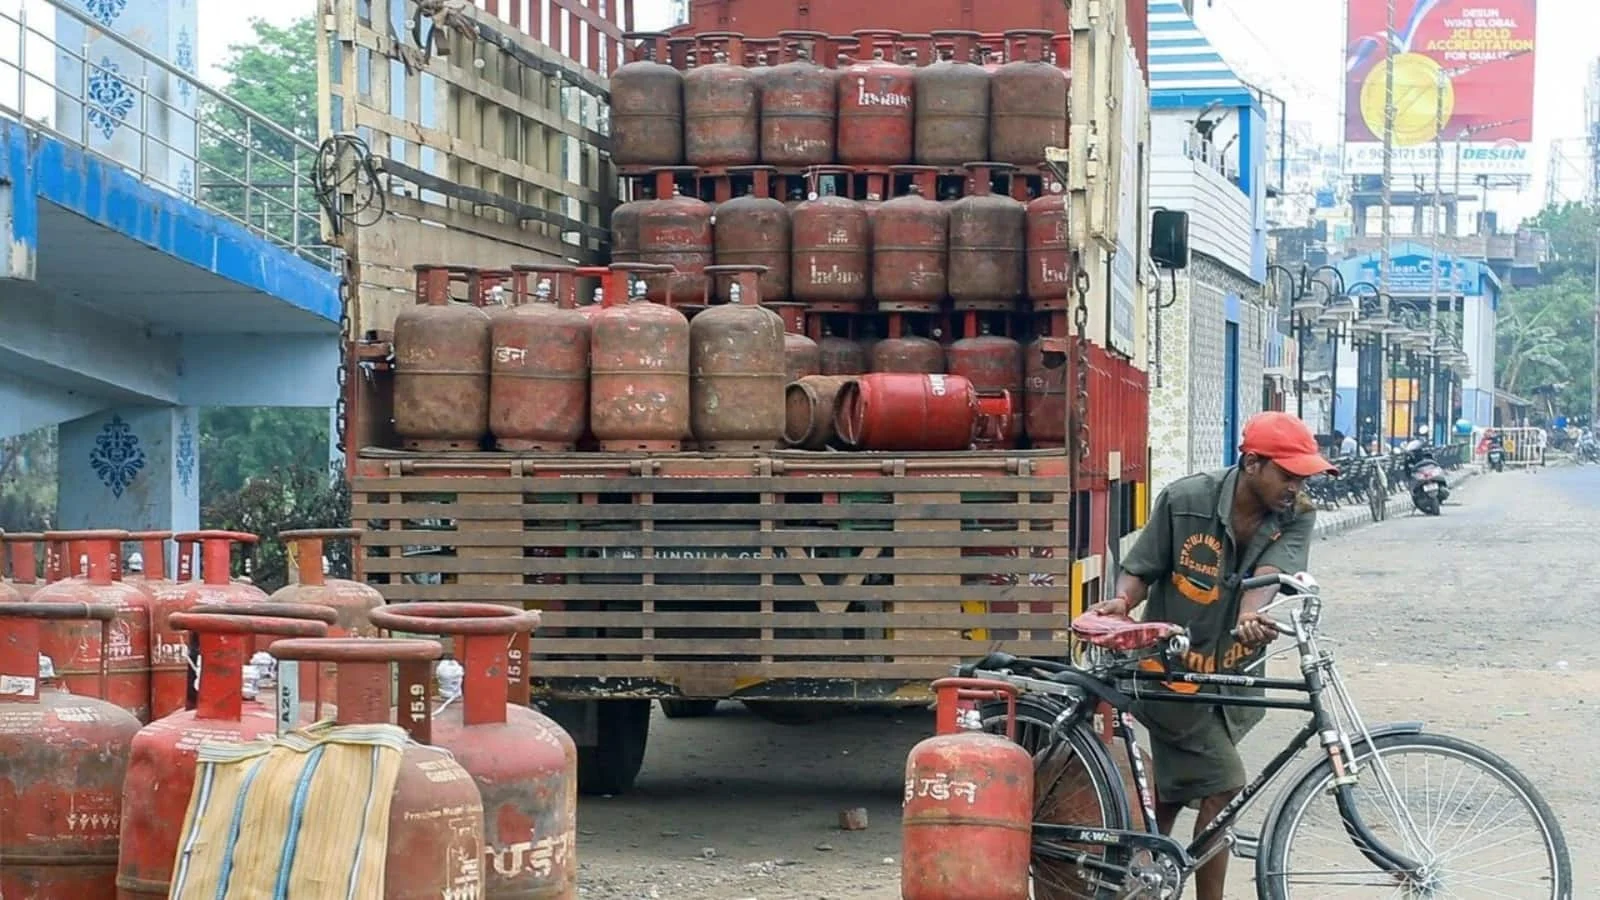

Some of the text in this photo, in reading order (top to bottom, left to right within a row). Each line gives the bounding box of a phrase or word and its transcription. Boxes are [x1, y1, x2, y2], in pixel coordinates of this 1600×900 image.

[1462, 8, 1499, 17] DESUN
[1444, 18, 1518, 28] WINS GLOBAL
[1450, 29, 1511, 39] JCI GOLD
[1427, 40, 1534, 50] ACCREDITATION
[1444, 52, 1467, 60] FOR
[1463, 148, 1527, 160] DESUN
[507, 648, 522, 685] 15.6
[410, 683, 425, 722] 15.9
